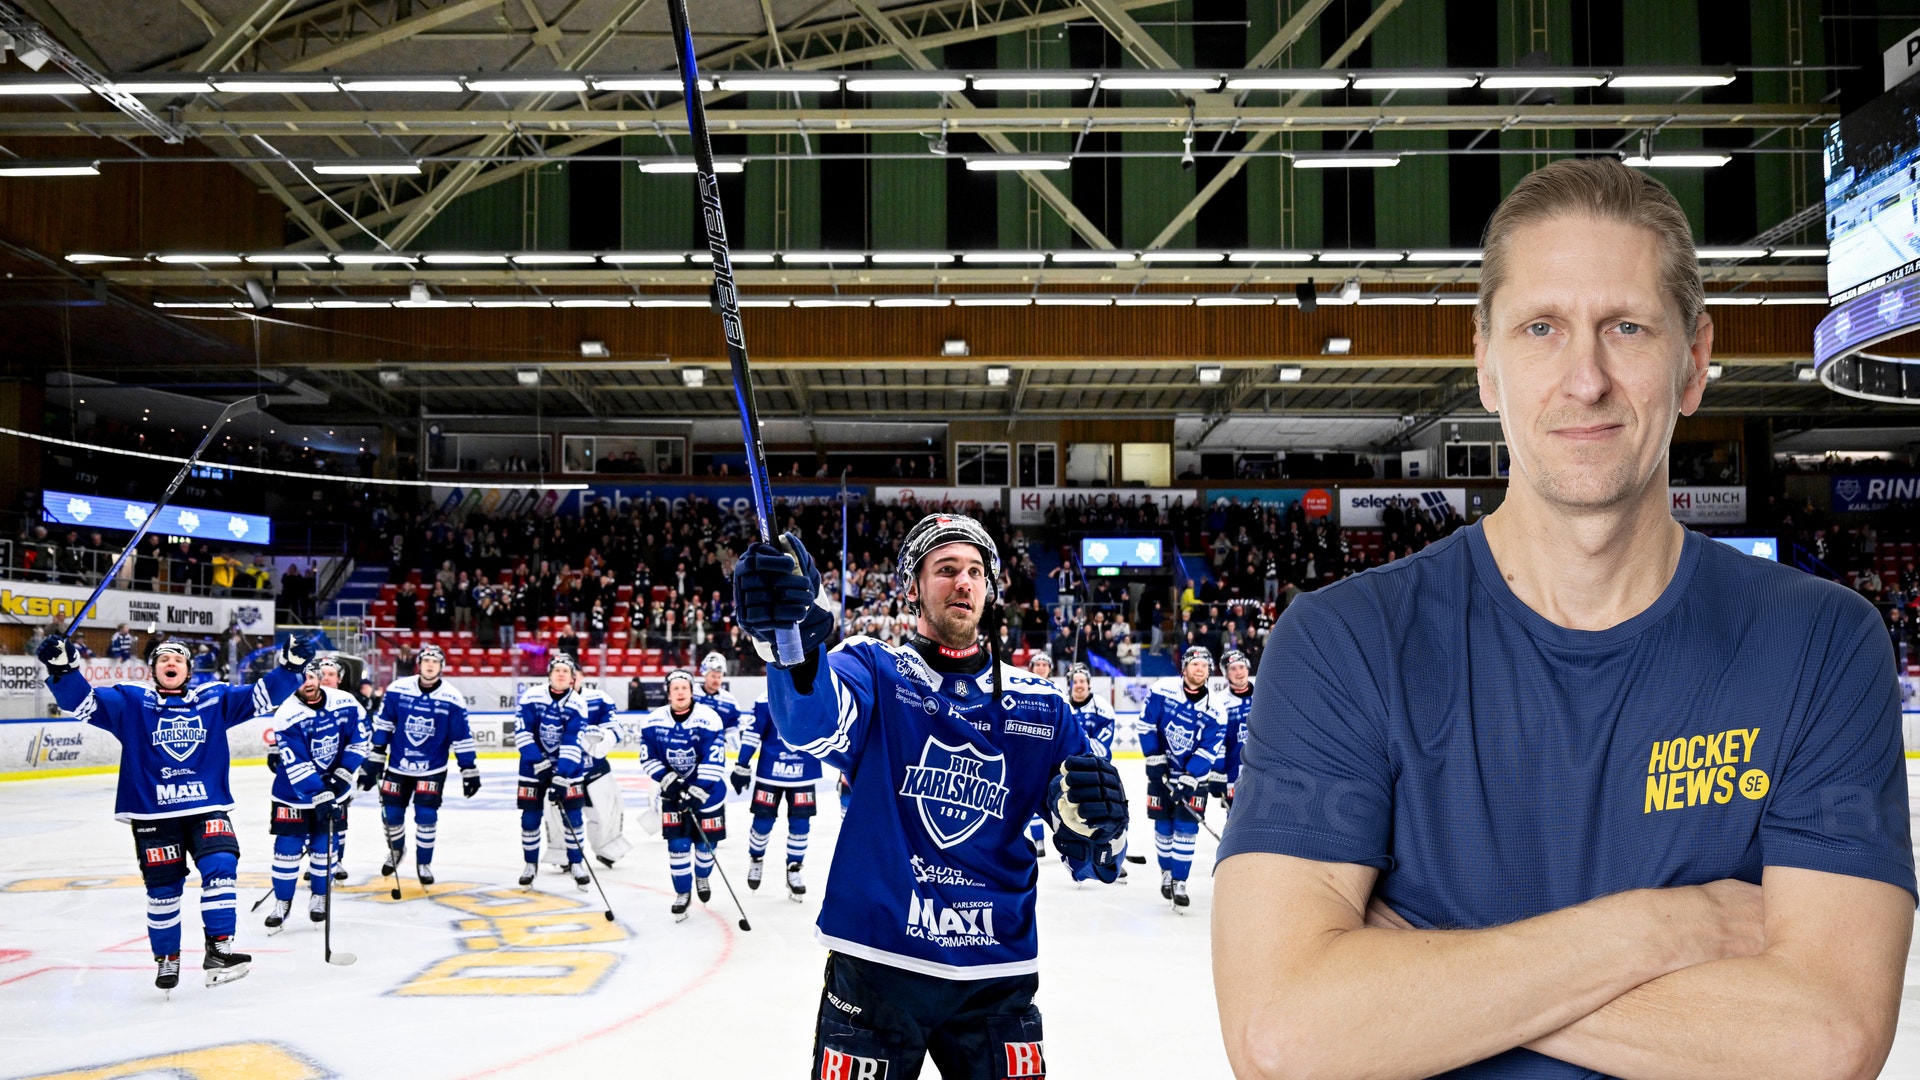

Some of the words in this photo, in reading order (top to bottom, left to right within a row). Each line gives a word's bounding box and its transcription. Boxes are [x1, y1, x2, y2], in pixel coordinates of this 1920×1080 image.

[698, 171, 745, 350] BAUER
[1695, 492, 1740, 504] LUNCH
[129, 610, 159, 623] TIDNING
[166, 605, 213, 626] Kuriren
[1, 664, 40, 679] happy
[84, 666, 112, 680] OCK
[1017, 700, 1050, 708] KARLSKOGA
[1006, 720, 1052, 737] ÖSTERBERGS
[42, 732, 84, 747] Svensk
[153, 730, 207, 744] KARLSKOGA
[48, 748, 80, 762] Cater
[1648, 727, 1761, 774] HOCKEY
[949, 756, 980, 777] BIK
[156, 784, 208, 801] MAXI
[902, 767, 1008, 818] KARLSKOGA
[1644, 765, 1737, 814] NEWS
[1744, 775, 1764, 793] SE
[940, 806, 968, 821] 1978
[923, 864, 962, 877] AUTO
[952, 901, 993, 909] KARLSKOGA
[906, 889, 995, 937] MAXI
[905, 925, 925, 939] ICA
